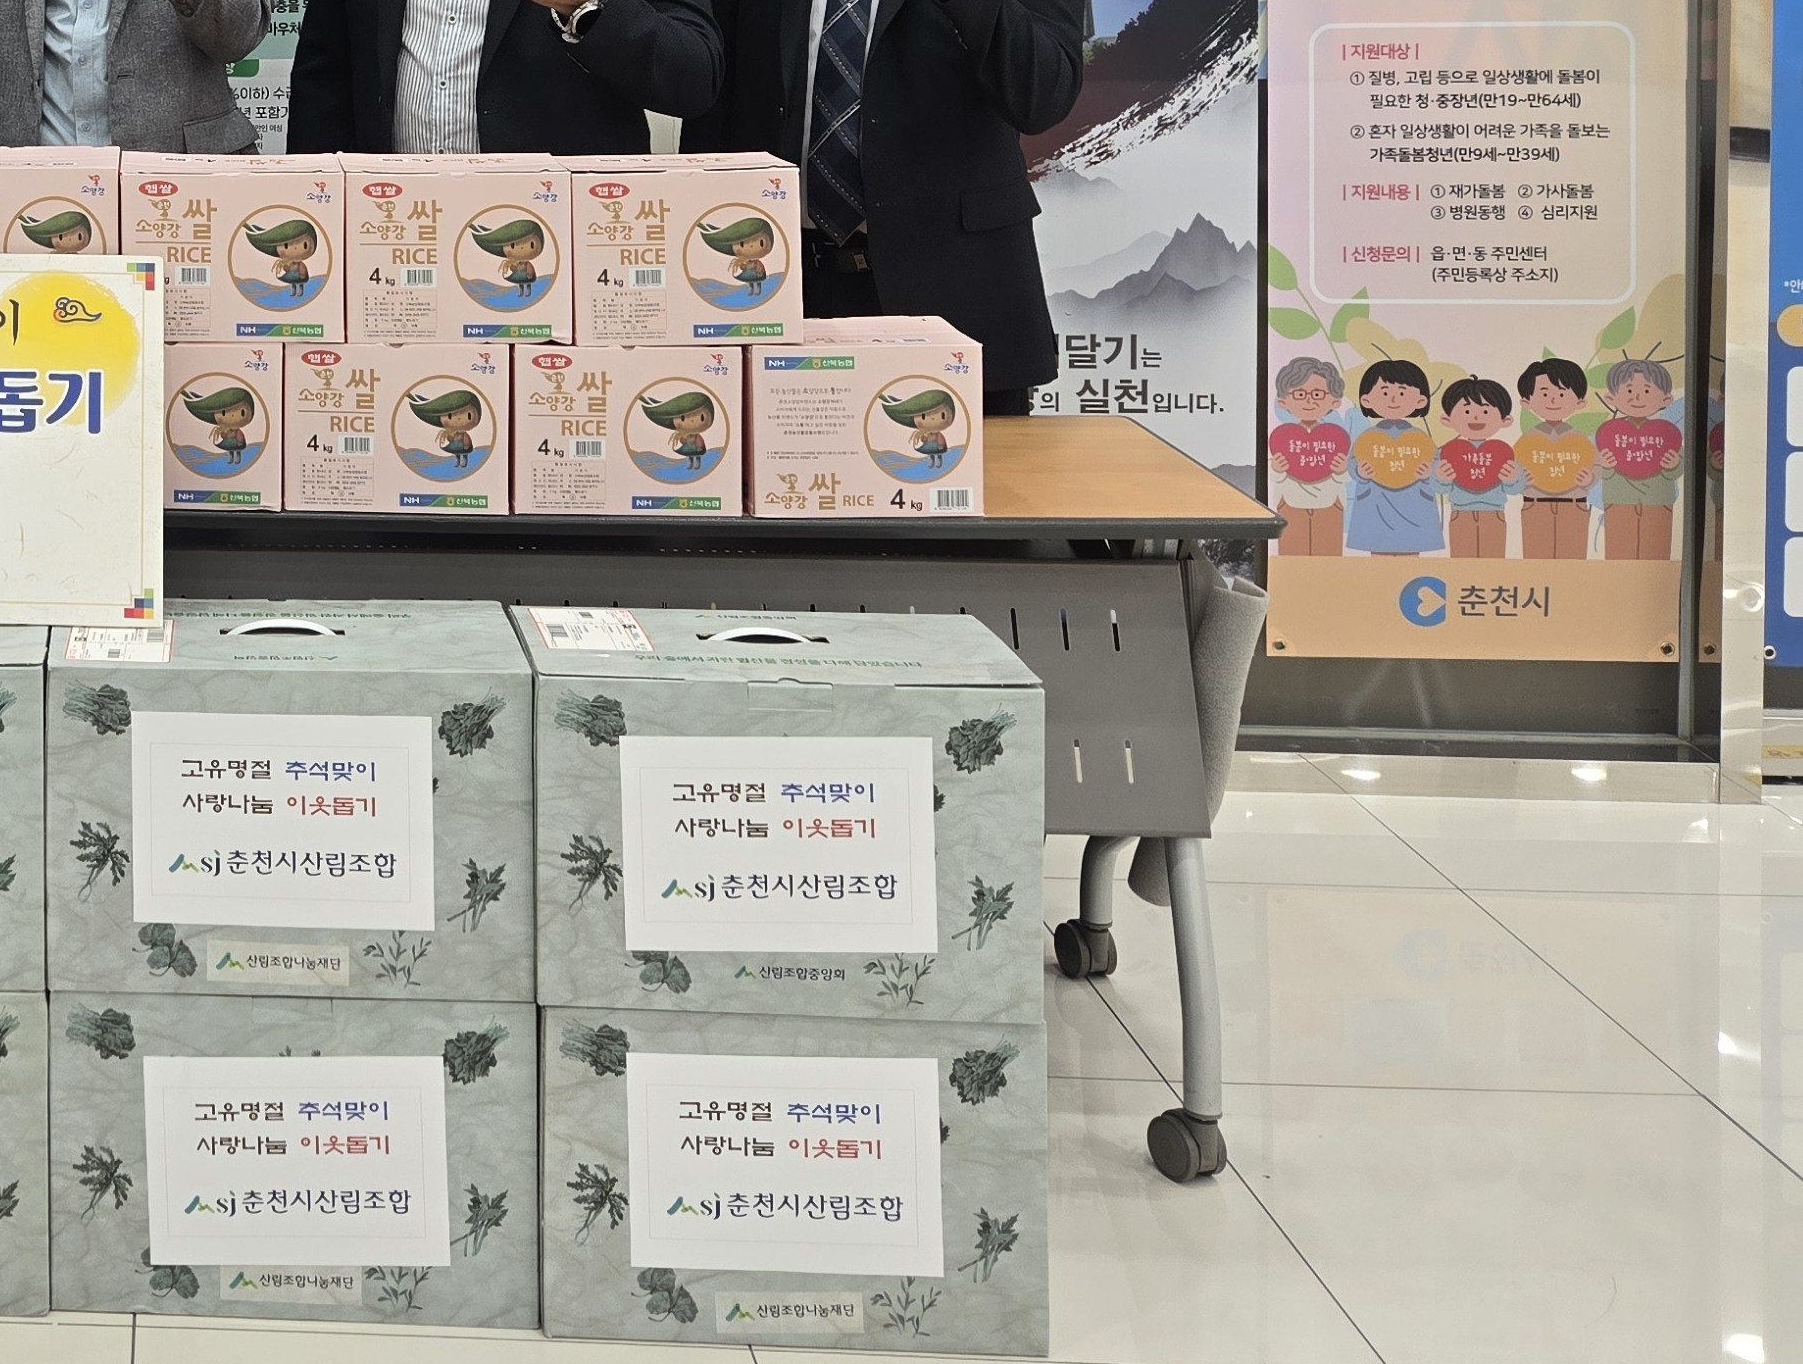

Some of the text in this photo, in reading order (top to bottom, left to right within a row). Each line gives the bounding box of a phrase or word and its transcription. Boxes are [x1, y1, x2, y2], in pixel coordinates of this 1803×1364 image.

[1368, 69, 1600, 86] 질병, 고립 등으로 일상생활에 돌봄이
[1370, 94, 1411, 109] 필요한
[1369, 123, 1610, 139] 혼자 일상생활이 어려운 가족을 돌보는
[1449, 184, 1505, 199] 재가돌봄
[1536, 184, 1594, 199] 가사돌봄
[587, 199, 670, 241] 소양강 쌀
[1450, 205, 1598, 221] 병원동행 심리지원
[620, 248, 666, 265] RICE
[1491, 247, 1547, 262] 주민센터
[1432, 267, 1559, 283] (주민등록상 주소지)
[697, 326, 714, 335] NH
[1054, 333, 1162, 370] 달기는
[1075, 379, 1224, 414] 실천입니다.
[765, 491, 807, 509] 소양강
[809, 472, 841, 509] 쌀
[843, 494, 874, 506] RICE
[1458, 585, 1550, 617] 춘천시
[672, 782, 875, 804] 고유명절 추석맞이
[675, 817, 876, 839] 사랑나눔 이웃돕기
[759, 966, 845, 982] 산림조합중앙회
[194, 1101, 389, 1122] 고유명절 추석맞이
[197, 1135, 390, 1156] 사랑나눔 이웃돕기
[259, 1273, 354, 1290] 산림조합나눔재단
[757, 1302, 855, 1318] 산림조합나눔재단
